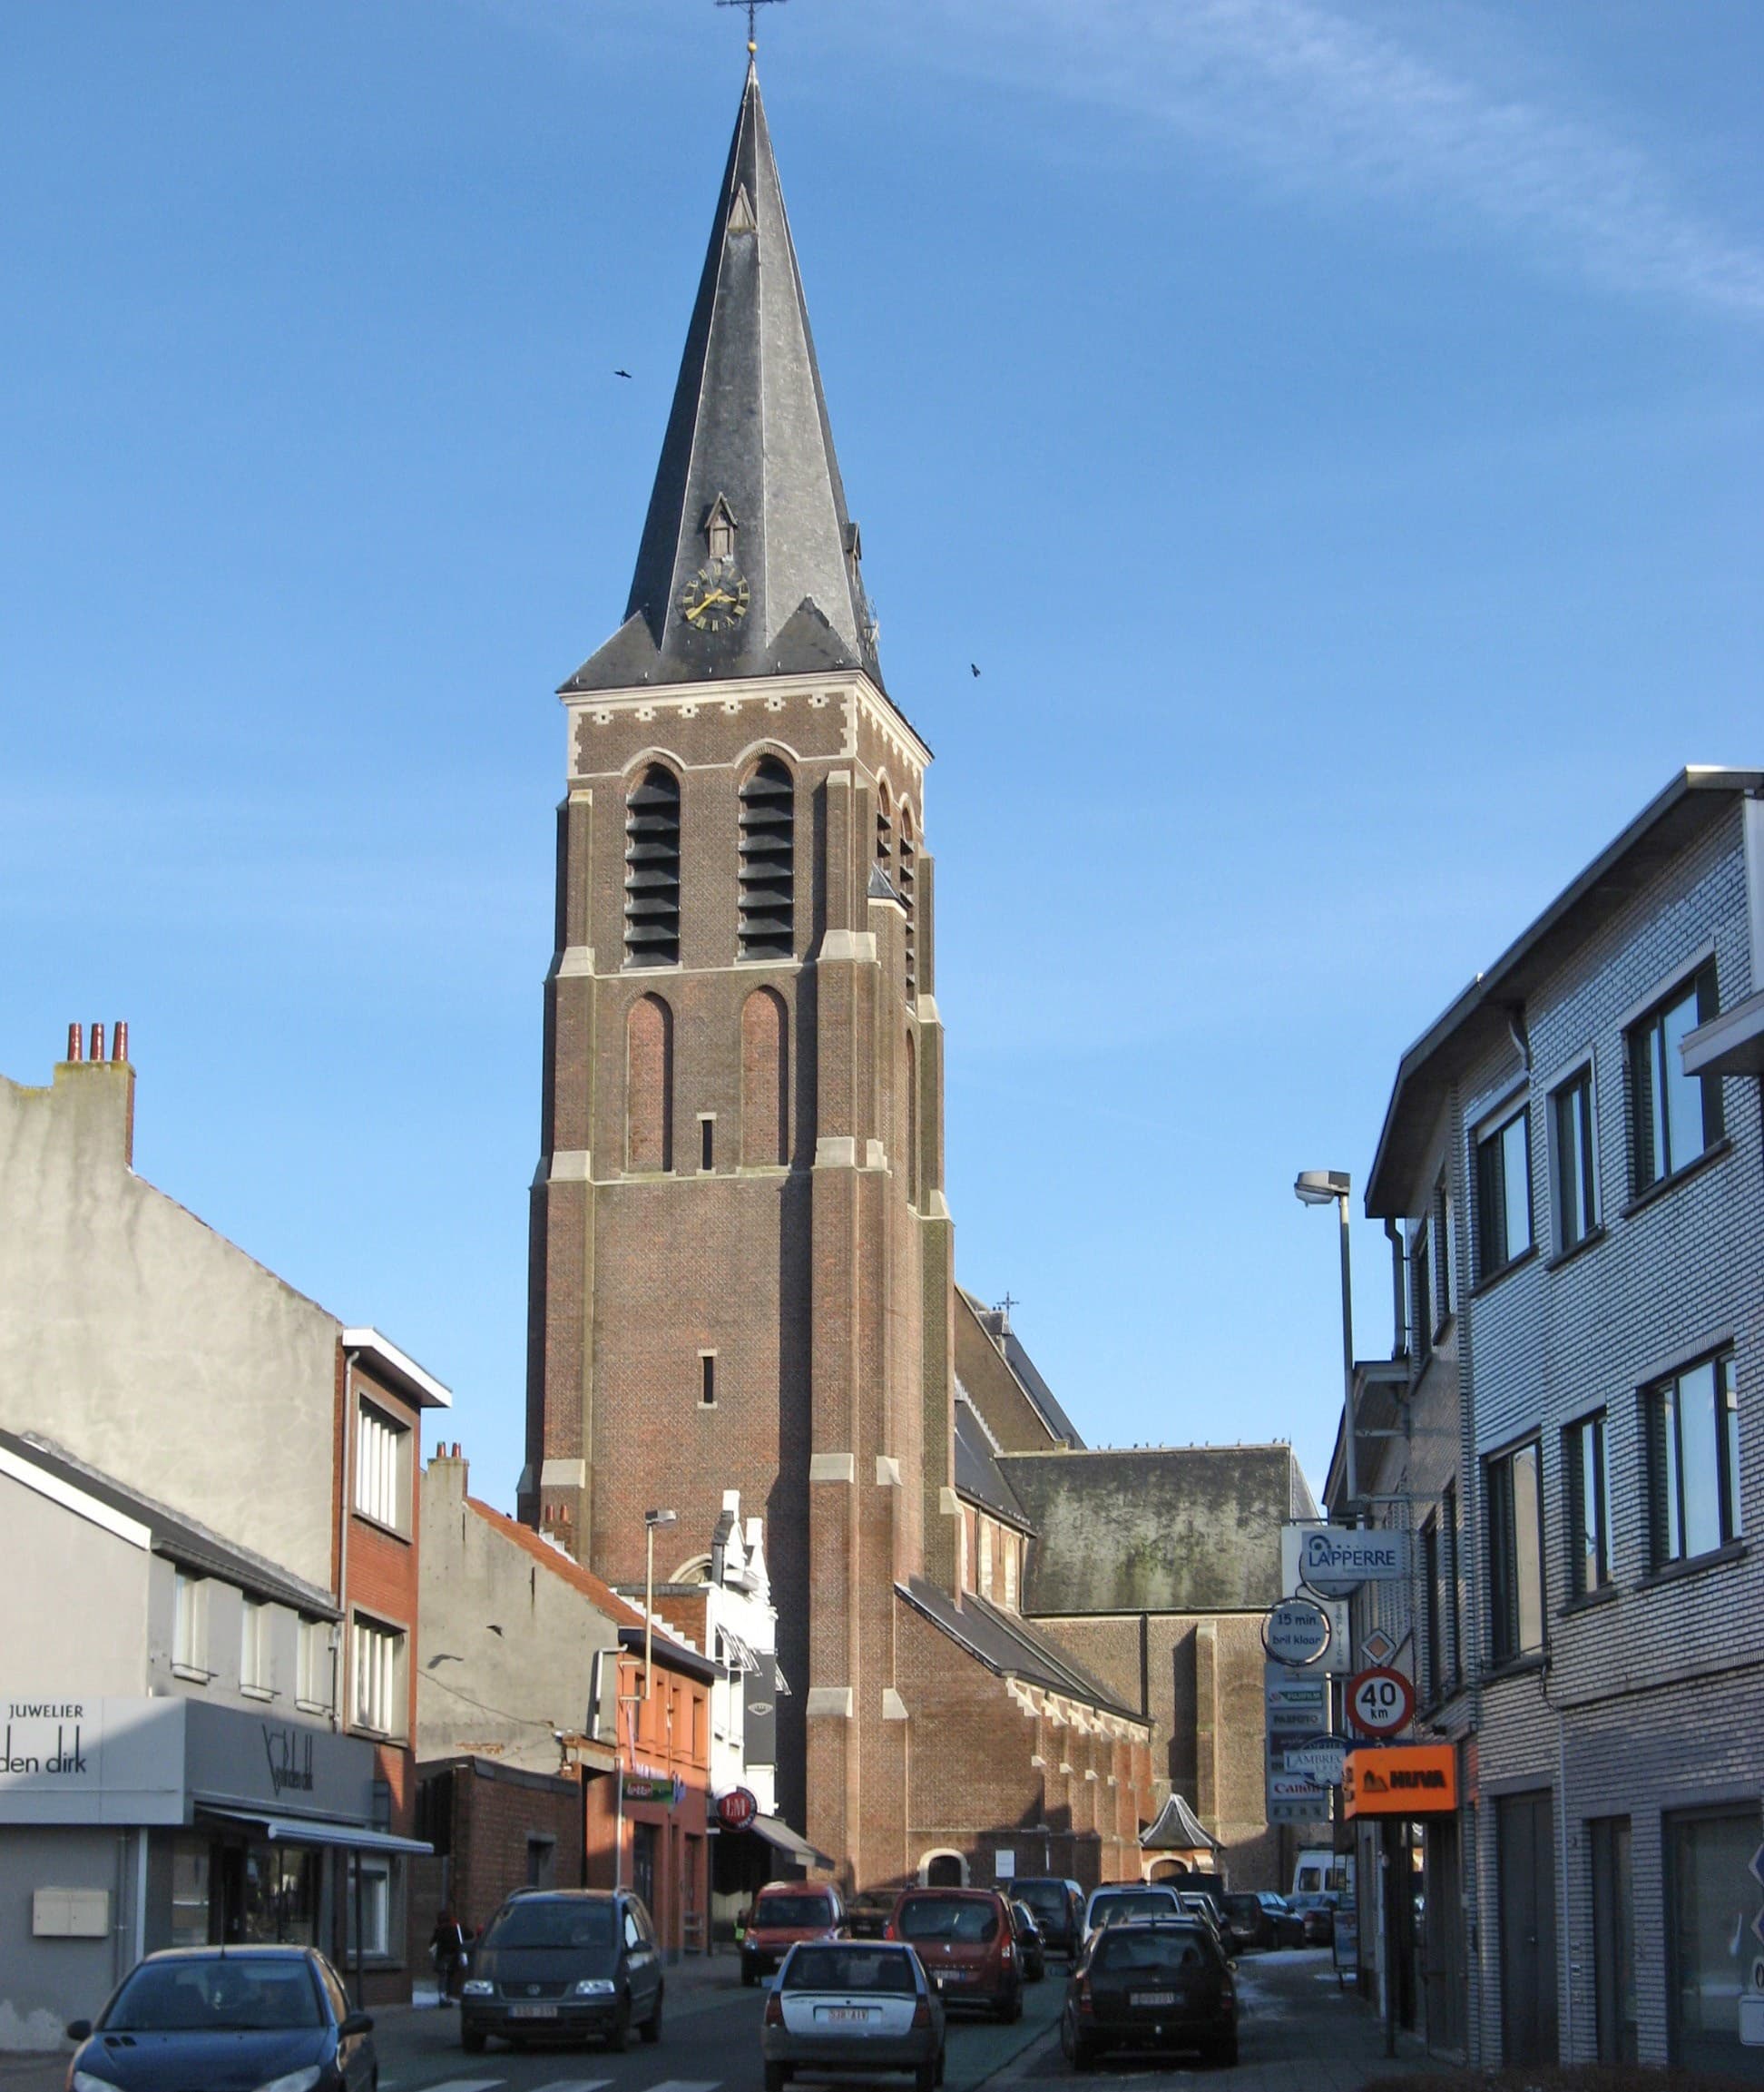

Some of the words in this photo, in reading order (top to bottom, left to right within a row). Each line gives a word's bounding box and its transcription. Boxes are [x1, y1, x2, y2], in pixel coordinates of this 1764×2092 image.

[1308, 1549, 1396, 1567] LAPPERRE
[1278, 1614, 1291, 1625] 15
[1273, 1635, 1290, 1645] bril
[1293, 1635, 1321, 1645] klaar
[1361, 1682, 1396, 1706] 40
[9, 1704, 83, 1719] JUWELIER
[1371, 1708, 1388, 1720] km
[45, 1724, 87, 1773] dirk
[1274, 1782, 1321, 1794] Canon
